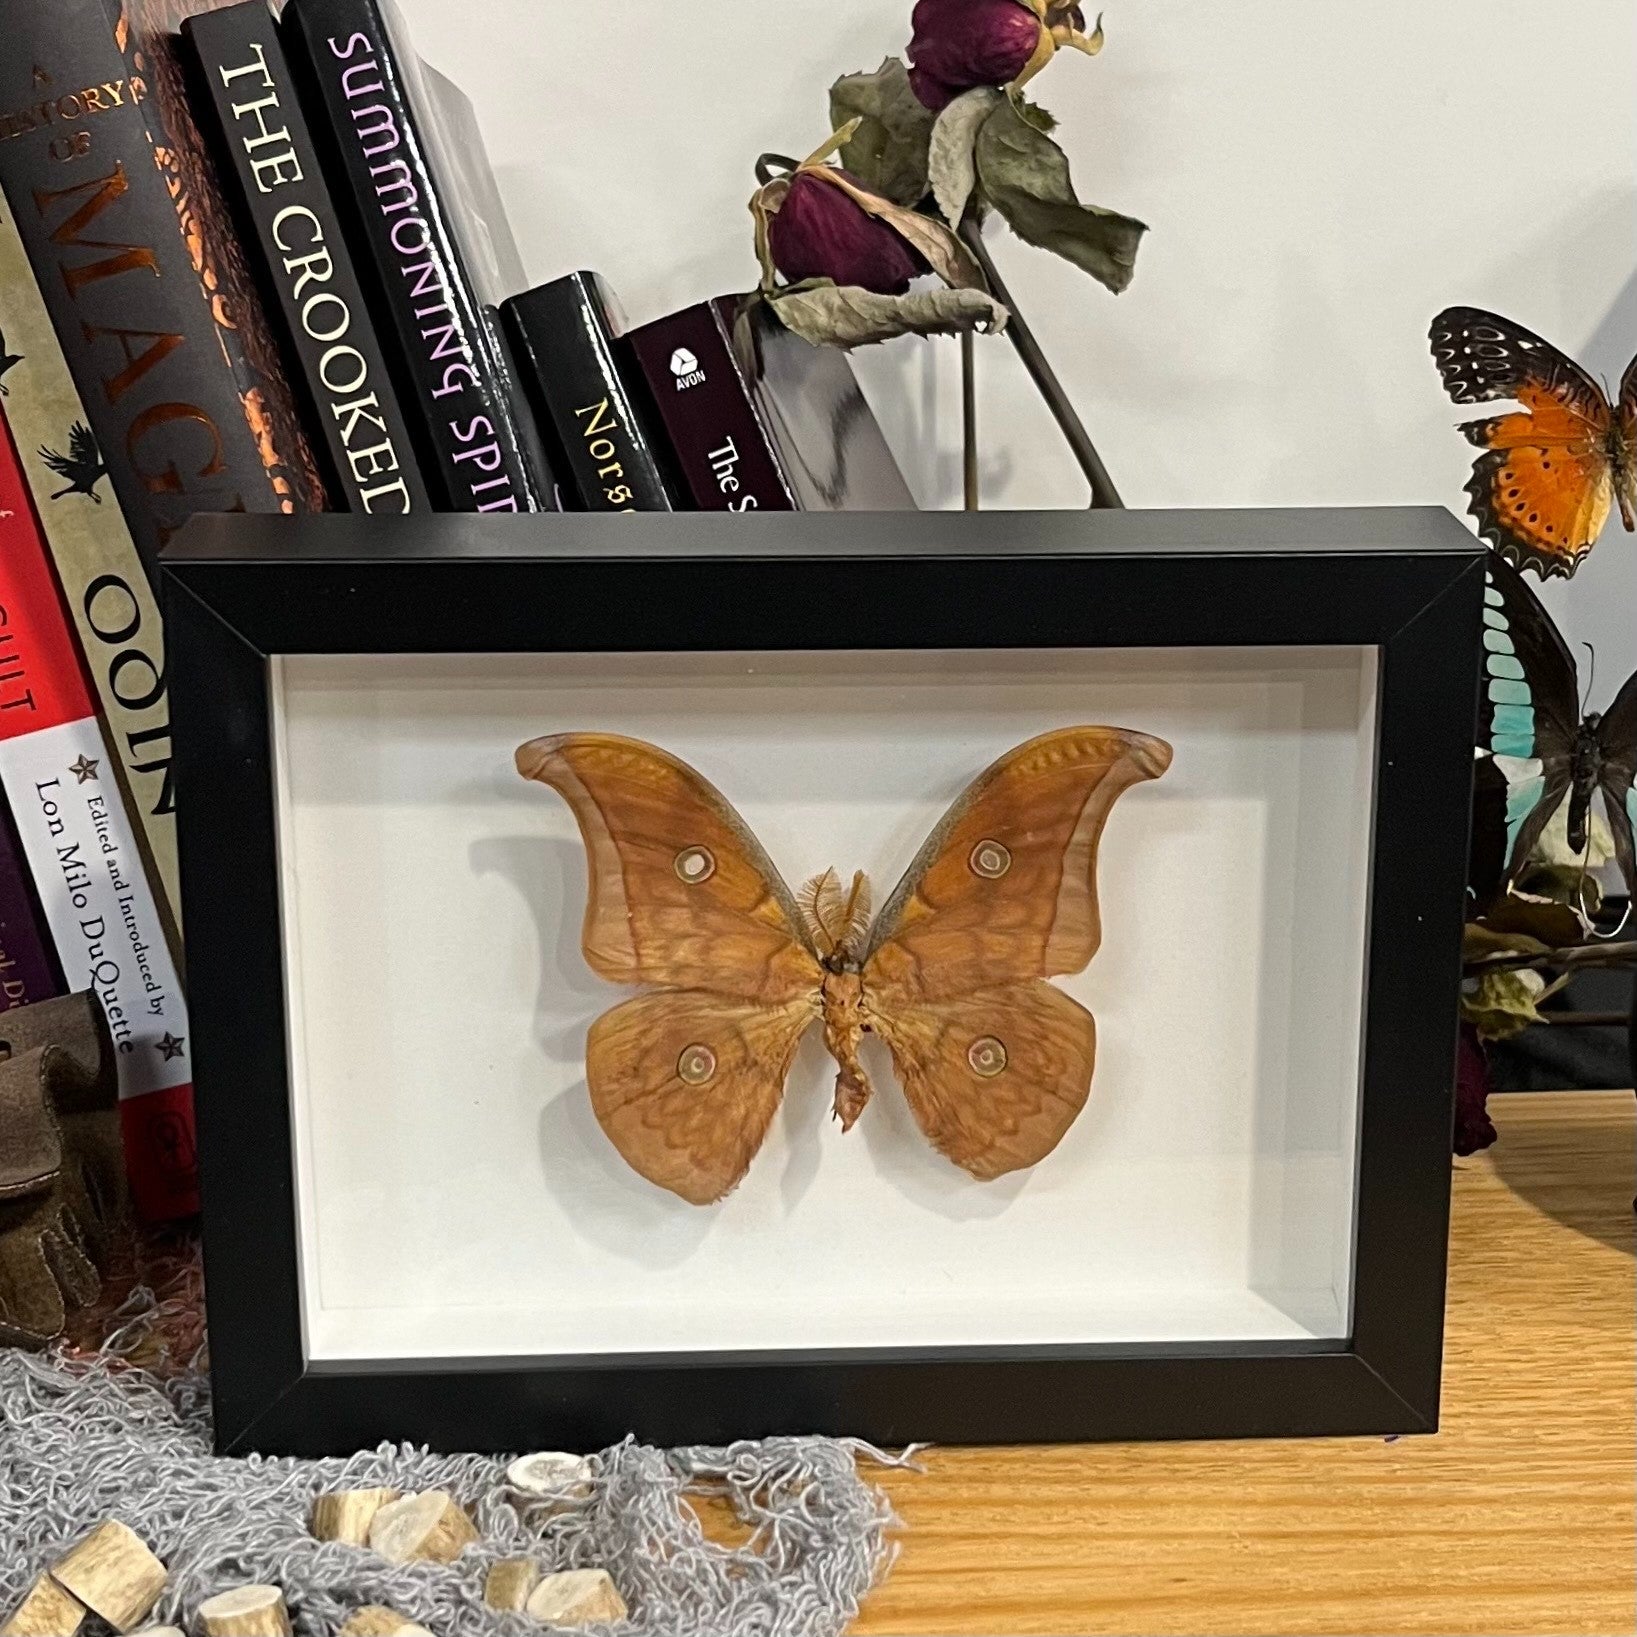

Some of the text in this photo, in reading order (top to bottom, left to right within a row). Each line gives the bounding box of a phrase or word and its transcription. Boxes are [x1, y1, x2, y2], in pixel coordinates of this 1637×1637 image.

[219, 43, 304, 193] THE
[328, 32, 482, 399] SUMMONING
[575, 397, 636, 513] Nors
[676, 370, 706, 391] AVON
[708, 435, 739, 493] The
[35, 777, 134, 1054] Lon Milo DuQuette
[87, 795, 164, 1017] Edited and Introduced by
